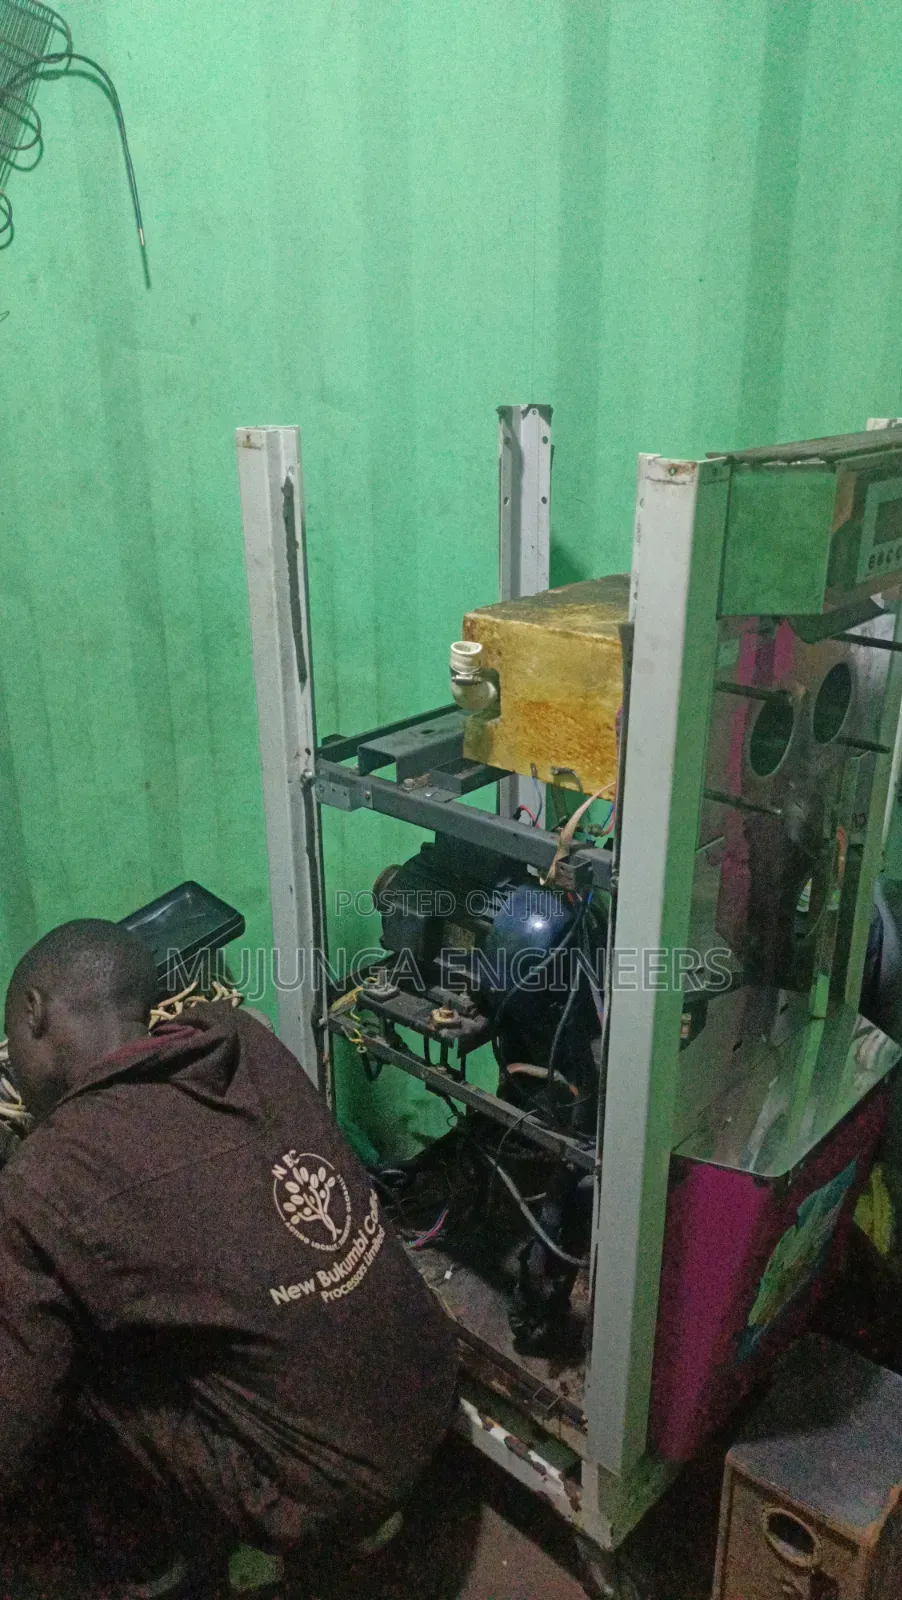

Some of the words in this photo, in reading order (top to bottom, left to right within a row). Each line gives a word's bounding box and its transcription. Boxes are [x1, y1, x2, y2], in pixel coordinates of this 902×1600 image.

[269, 1277, 316, 1306] New
[316, 1229, 369, 1288] Bukumbi
[320, 1264, 368, 1304] Processors
[363, 1224, 386, 1267] Limited
